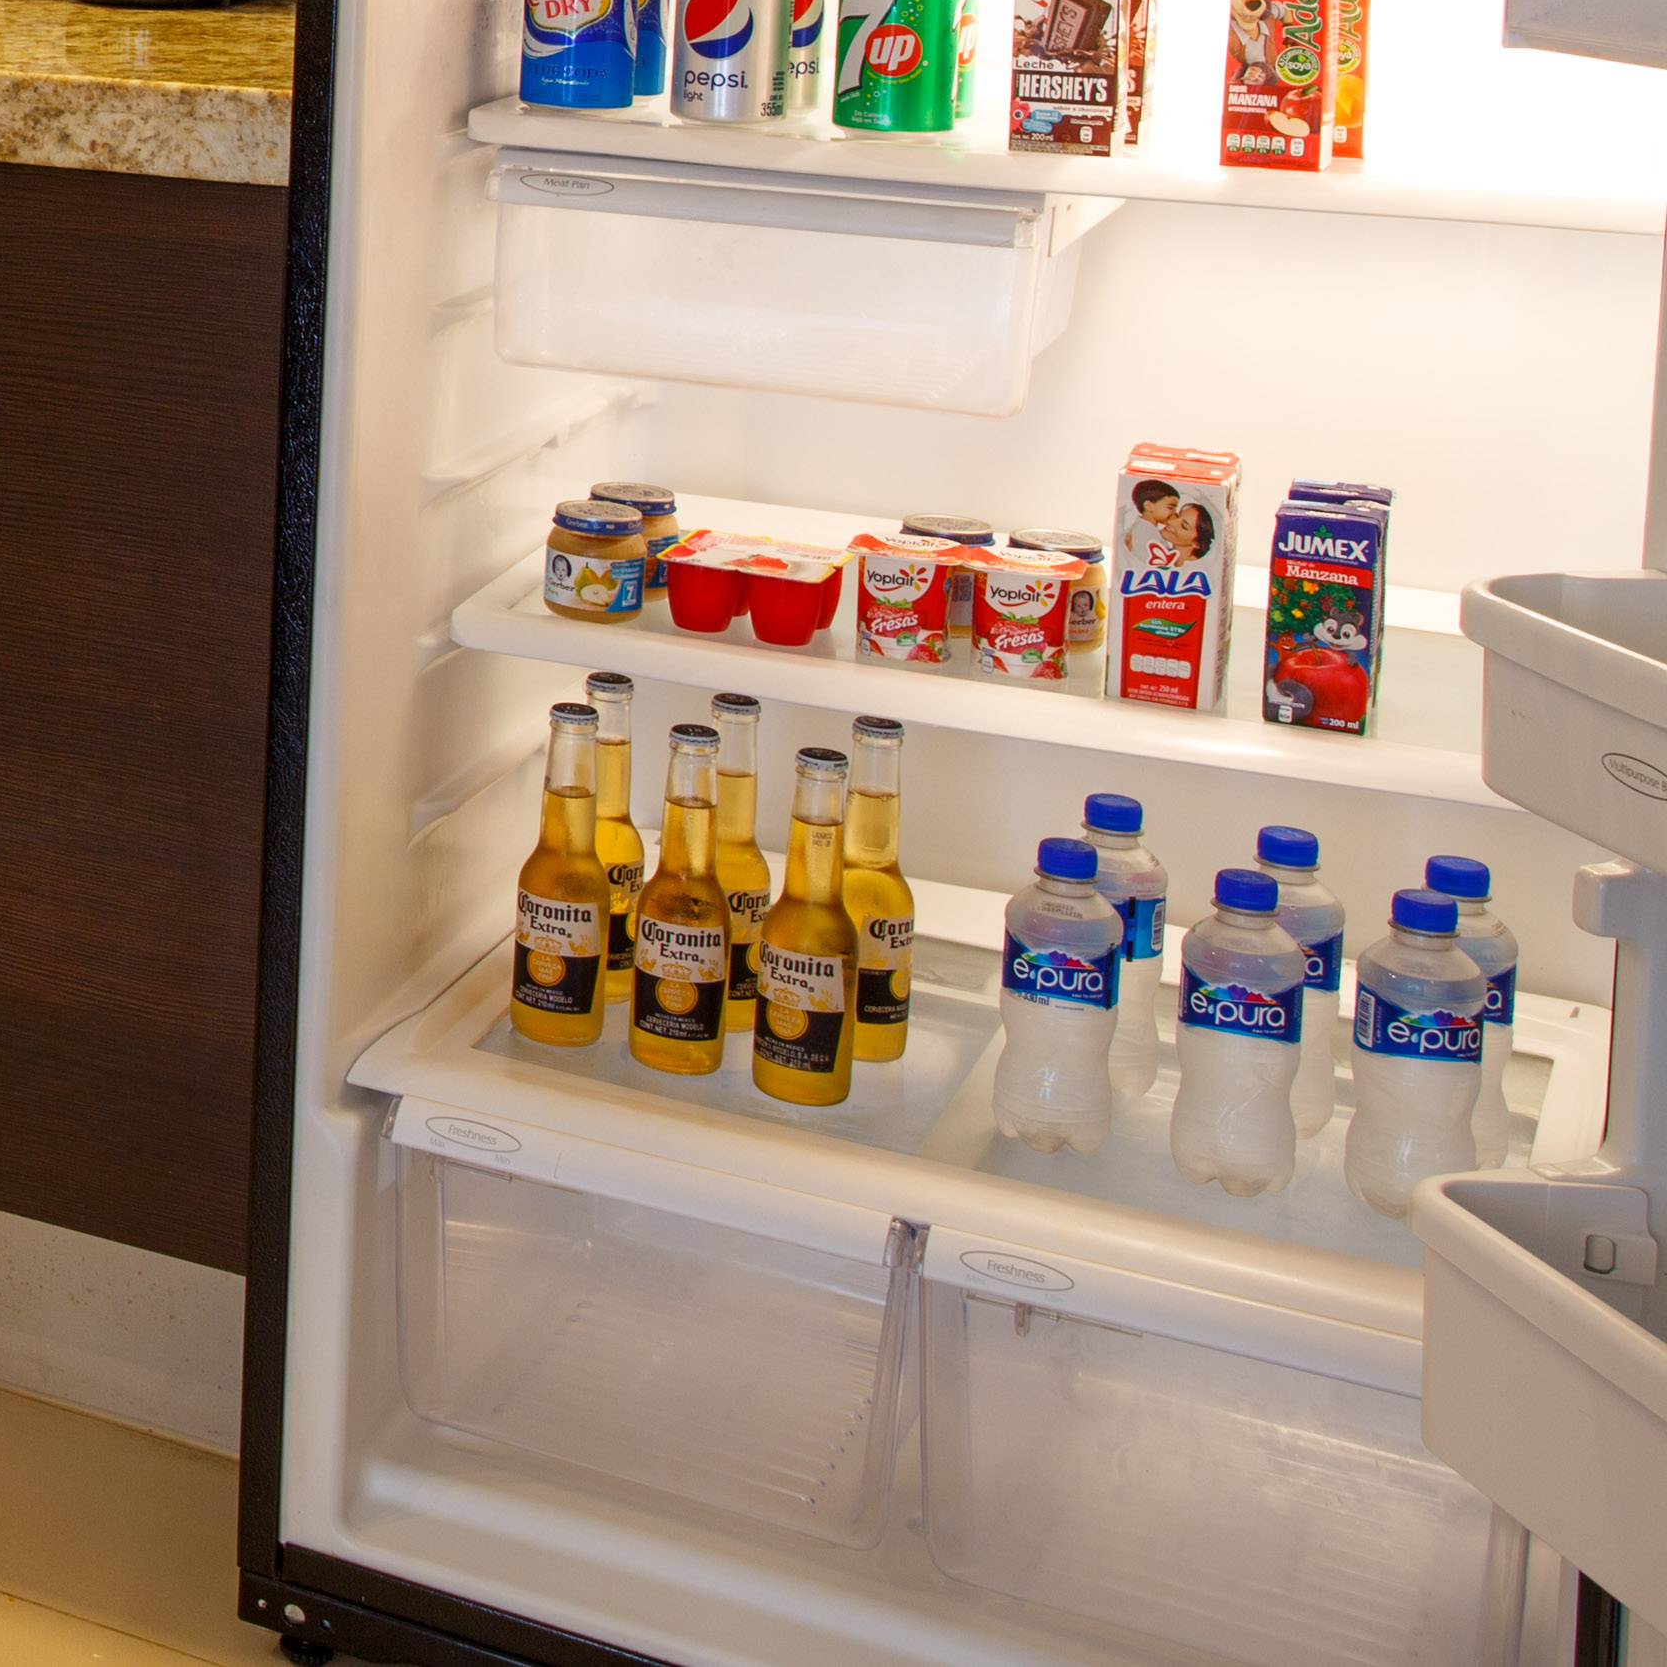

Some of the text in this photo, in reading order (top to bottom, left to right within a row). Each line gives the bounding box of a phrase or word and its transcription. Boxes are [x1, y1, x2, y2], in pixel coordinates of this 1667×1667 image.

[527, 62, 608, 79] CLUB SODA
[1015, 58, 1055, 70] Leche
[1287, 60, 1312, 72] soya
[684, 70, 746, 91] pepsi
[1018, 74, 1108, 102] HERSHEY'S
[683, 90, 703, 102] light
[1228, 93, 1277, 108] MANZANA
[1278, 531, 1370, 563] JUMEX
[547, 577, 576, 592] Gerber
[1120, 570, 1212, 597] LALA
[1285, 565, 1359, 586] Manzana
[1145, 600, 1186, 610] entera
[1329, 718, 1359, 730] 200 ml
[1608, 758, 1660, 790] Multipurpose
[518, 890, 592, 923] Coronita
[530, 915, 567, 936] Extra
[641, 919, 721, 948] Coronita
[660, 943, 699, 963] Extra
[759, 939, 835, 978] Coronita
[770, 966, 809, 990] Extra
[1038, 996, 1050, 1006] ml
[645, 1015, 704, 1031] CERVECERIA MODELO
[448, 1123, 499, 1146] Freshness
[987, 1258, 1047, 1284] Freshness
